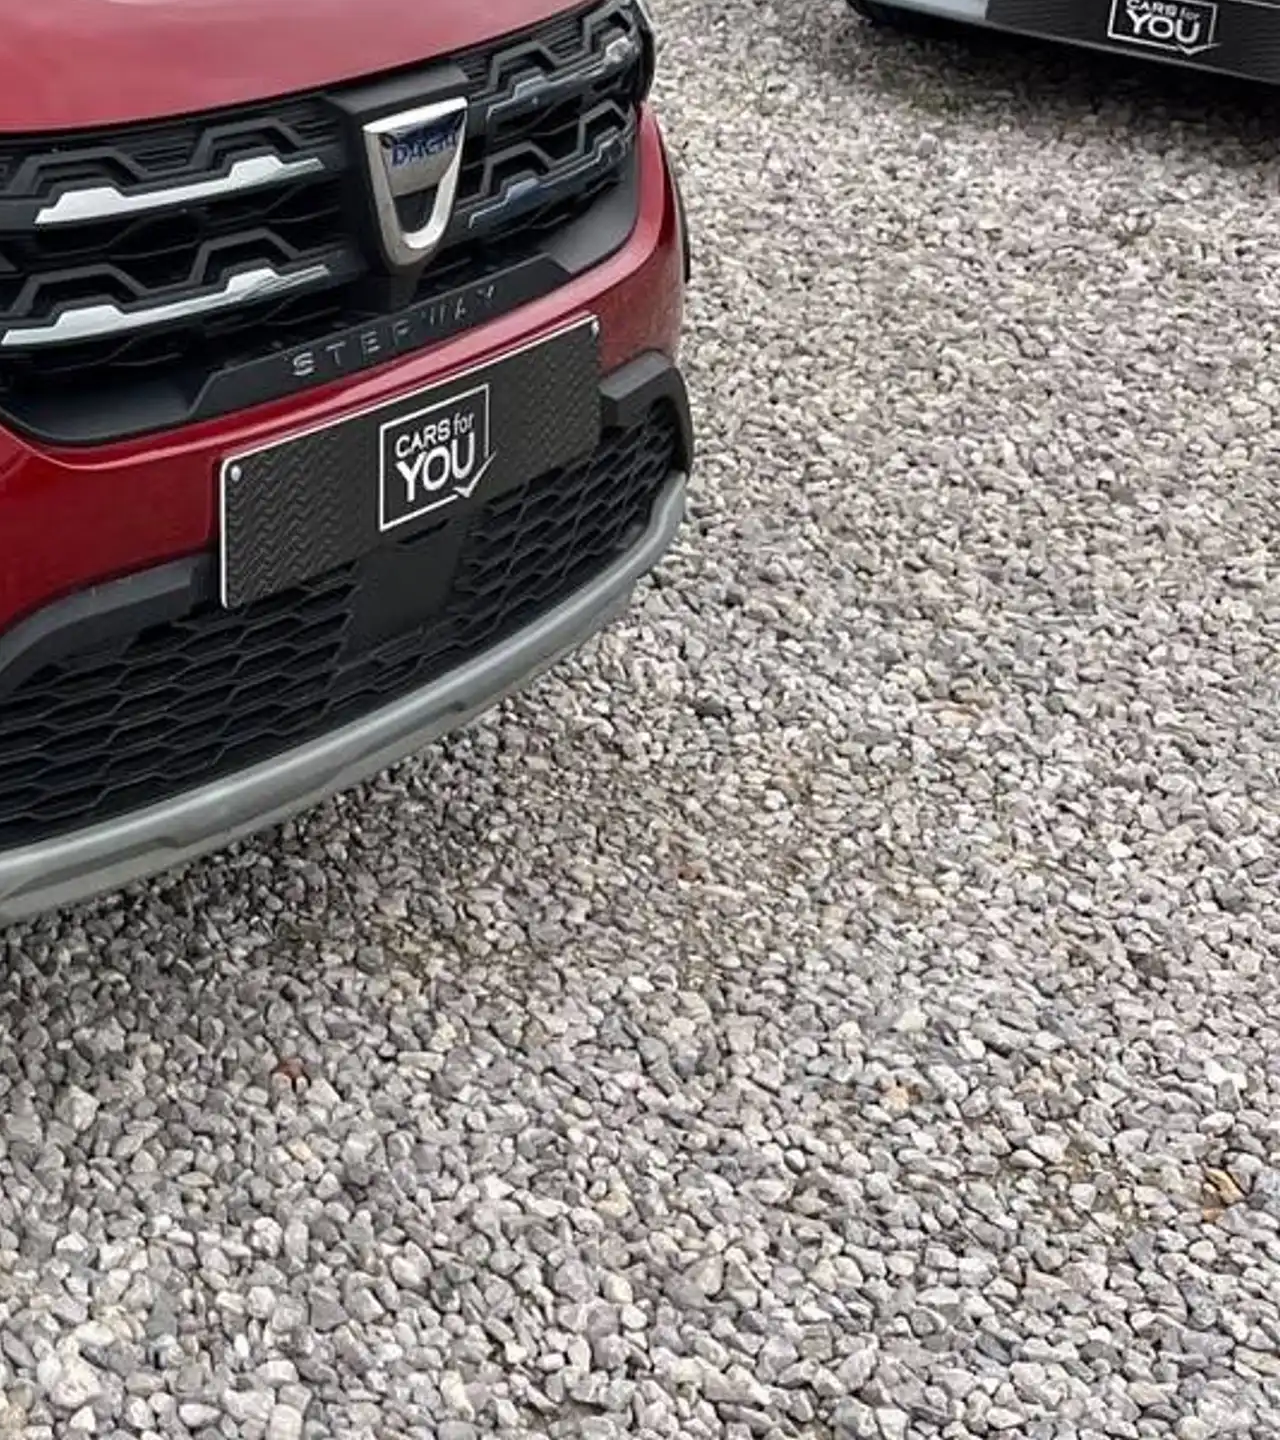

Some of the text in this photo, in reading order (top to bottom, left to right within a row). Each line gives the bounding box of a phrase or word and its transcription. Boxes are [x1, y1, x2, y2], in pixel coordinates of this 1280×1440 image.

[1125, 8, 1200, 44] YOU
[395, 411, 474, 458] CARS for
[395, 432, 475, 502] YOU
